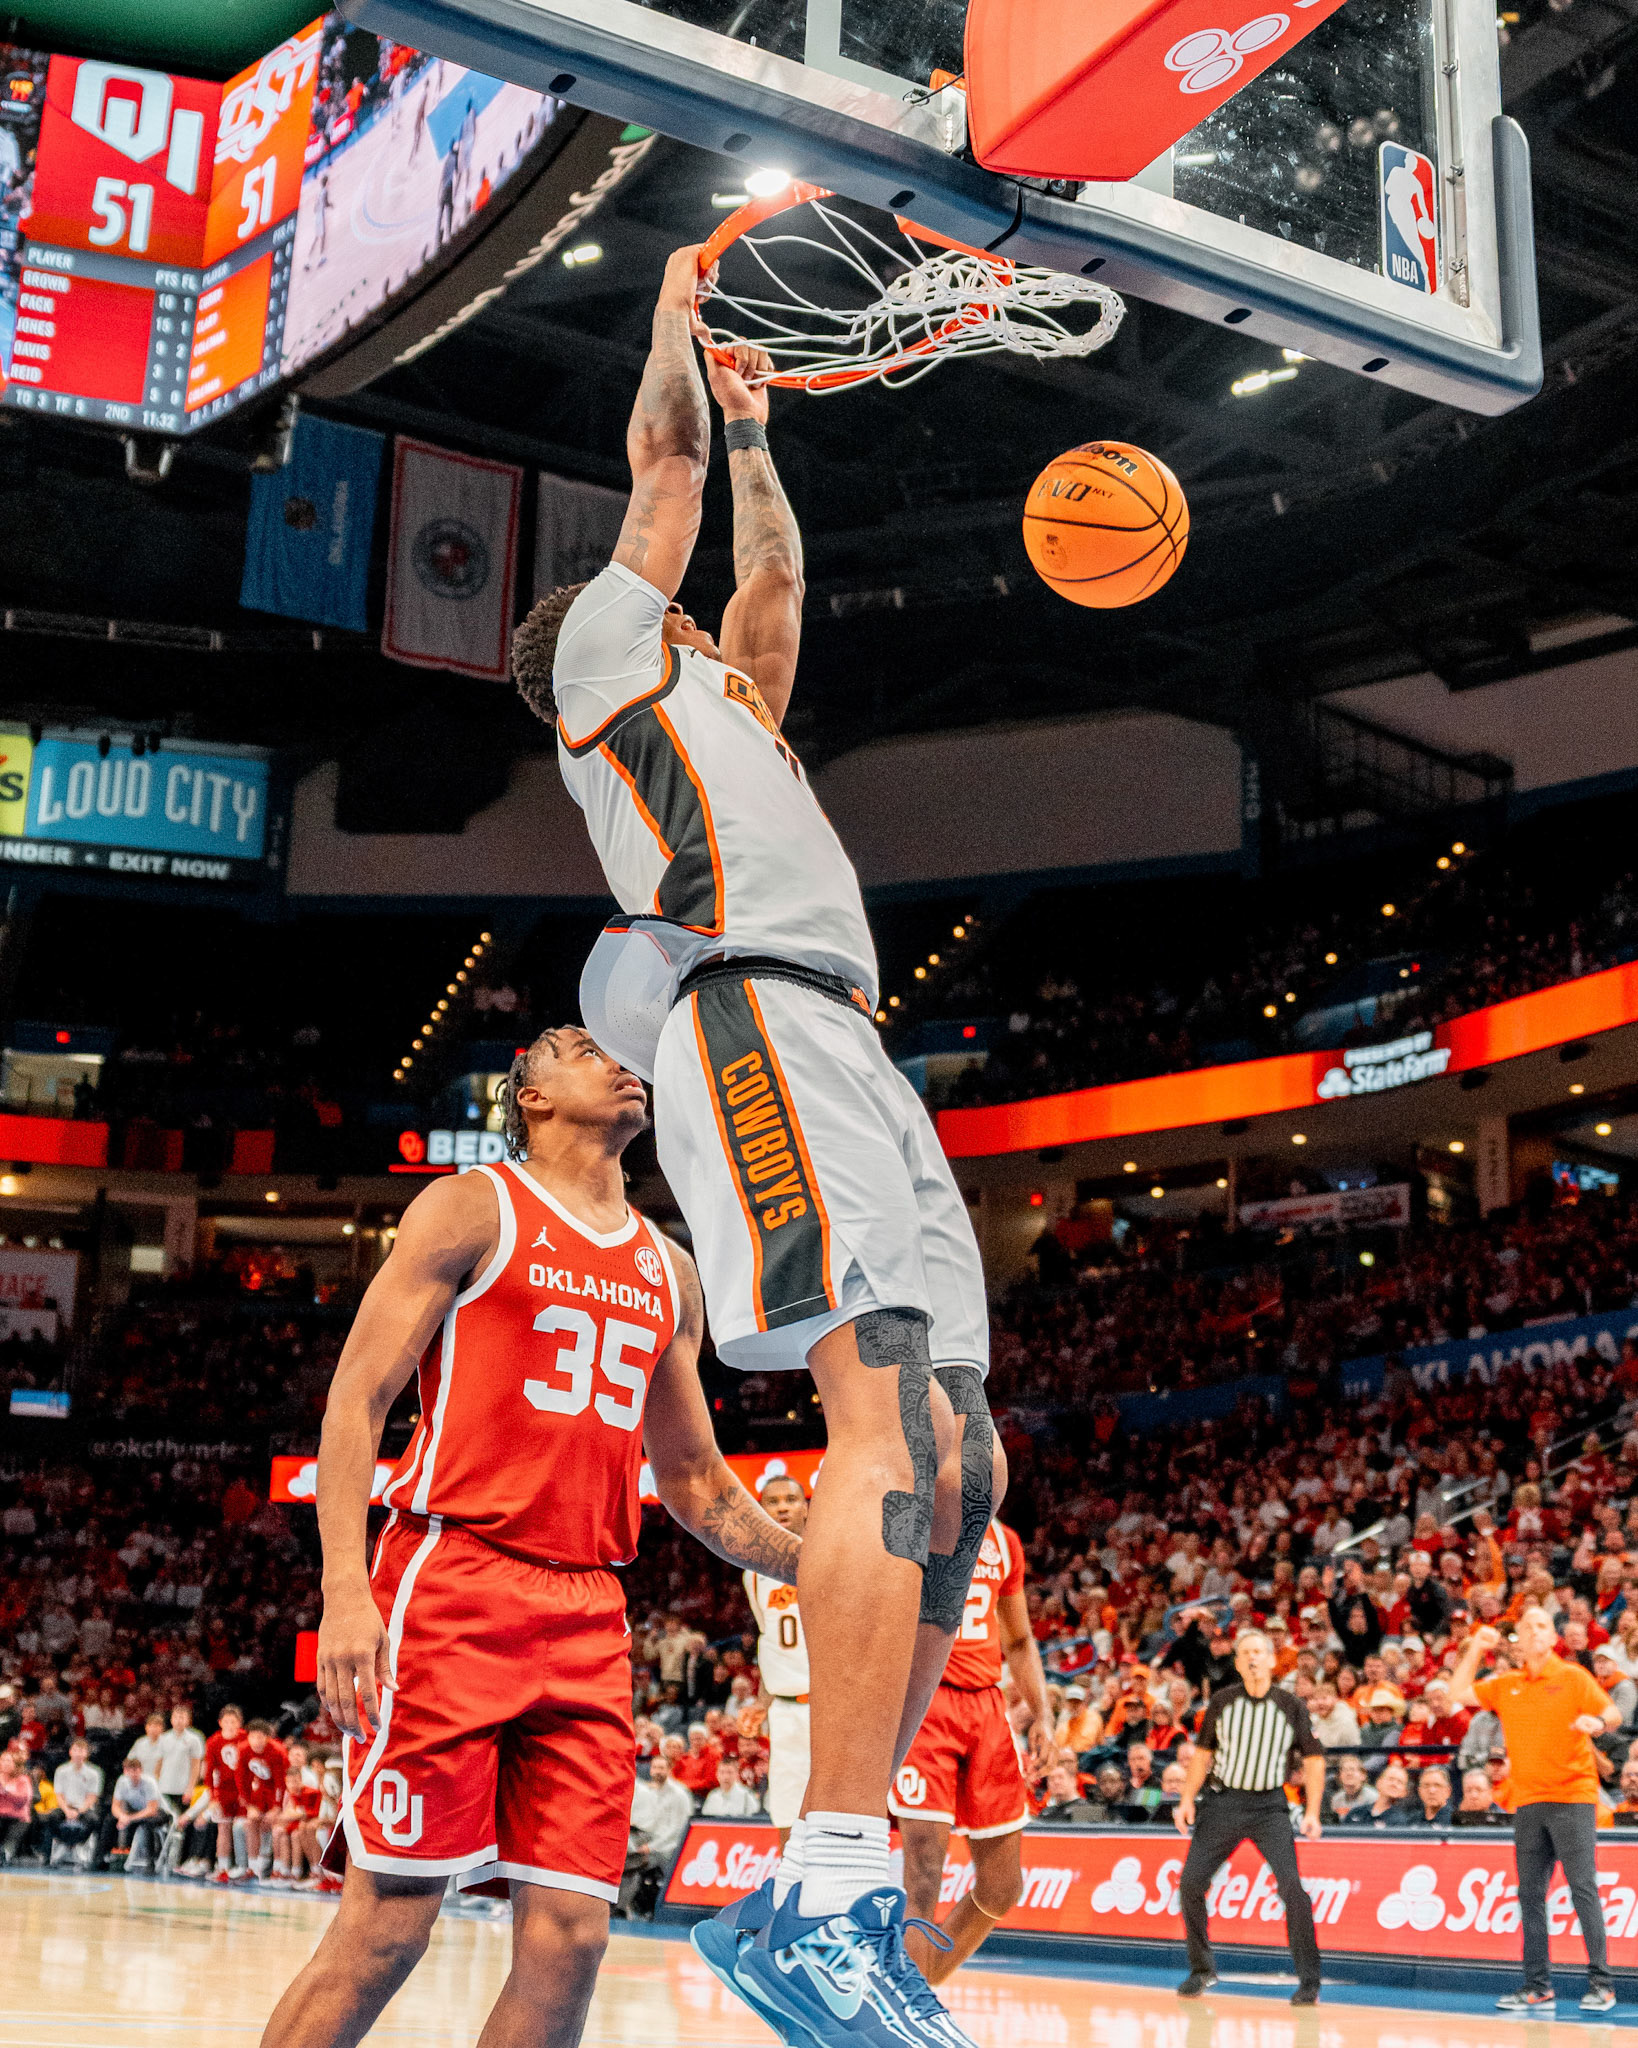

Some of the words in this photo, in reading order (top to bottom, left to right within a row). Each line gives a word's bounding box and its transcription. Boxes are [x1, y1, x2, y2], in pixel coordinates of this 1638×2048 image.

[88, 175, 154, 253] 51
[238, 155, 277, 239] 51
[22, 269, 71, 294] BROWN
[27, 247, 75, 270] PLAYER
[155, 268, 181, 290] PTS
[181, 273, 199, 292] FL
[1391, 253, 1419, 285] NBA
[13, 340, 51, 361] DAVIS
[16, 316, 57, 338] JONES
[175, 342, 188, 360] 2
[9, 363, 43, 383] REID
[16, 389, 36, 408] TO
[37, 393, 51, 410] 3
[54, 395, 73, 413] TF
[104, 403, 132, 421] 2ND
[142, 409, 180, 430] 11:32
[37, 759, 151, 825] LOUD
[164, 763, 258, 843] CITY
[0, 841, 74, 866] NDER
[108, 851, 167, 875] EXIT
[170, 856, 231, 881] NOW
[721, 1050, 808, 1232] COWBOYS
[637, 1249, 662, 1284] SEC
[528, 1263, 665, 1323] OKLAHOMA
[522, 1304, 658, 1432] 35
[779, 1614, 799, 1651] 0
[896, 1765, 927, 1806] OU
[371, 1768, 424, 1847] OU
